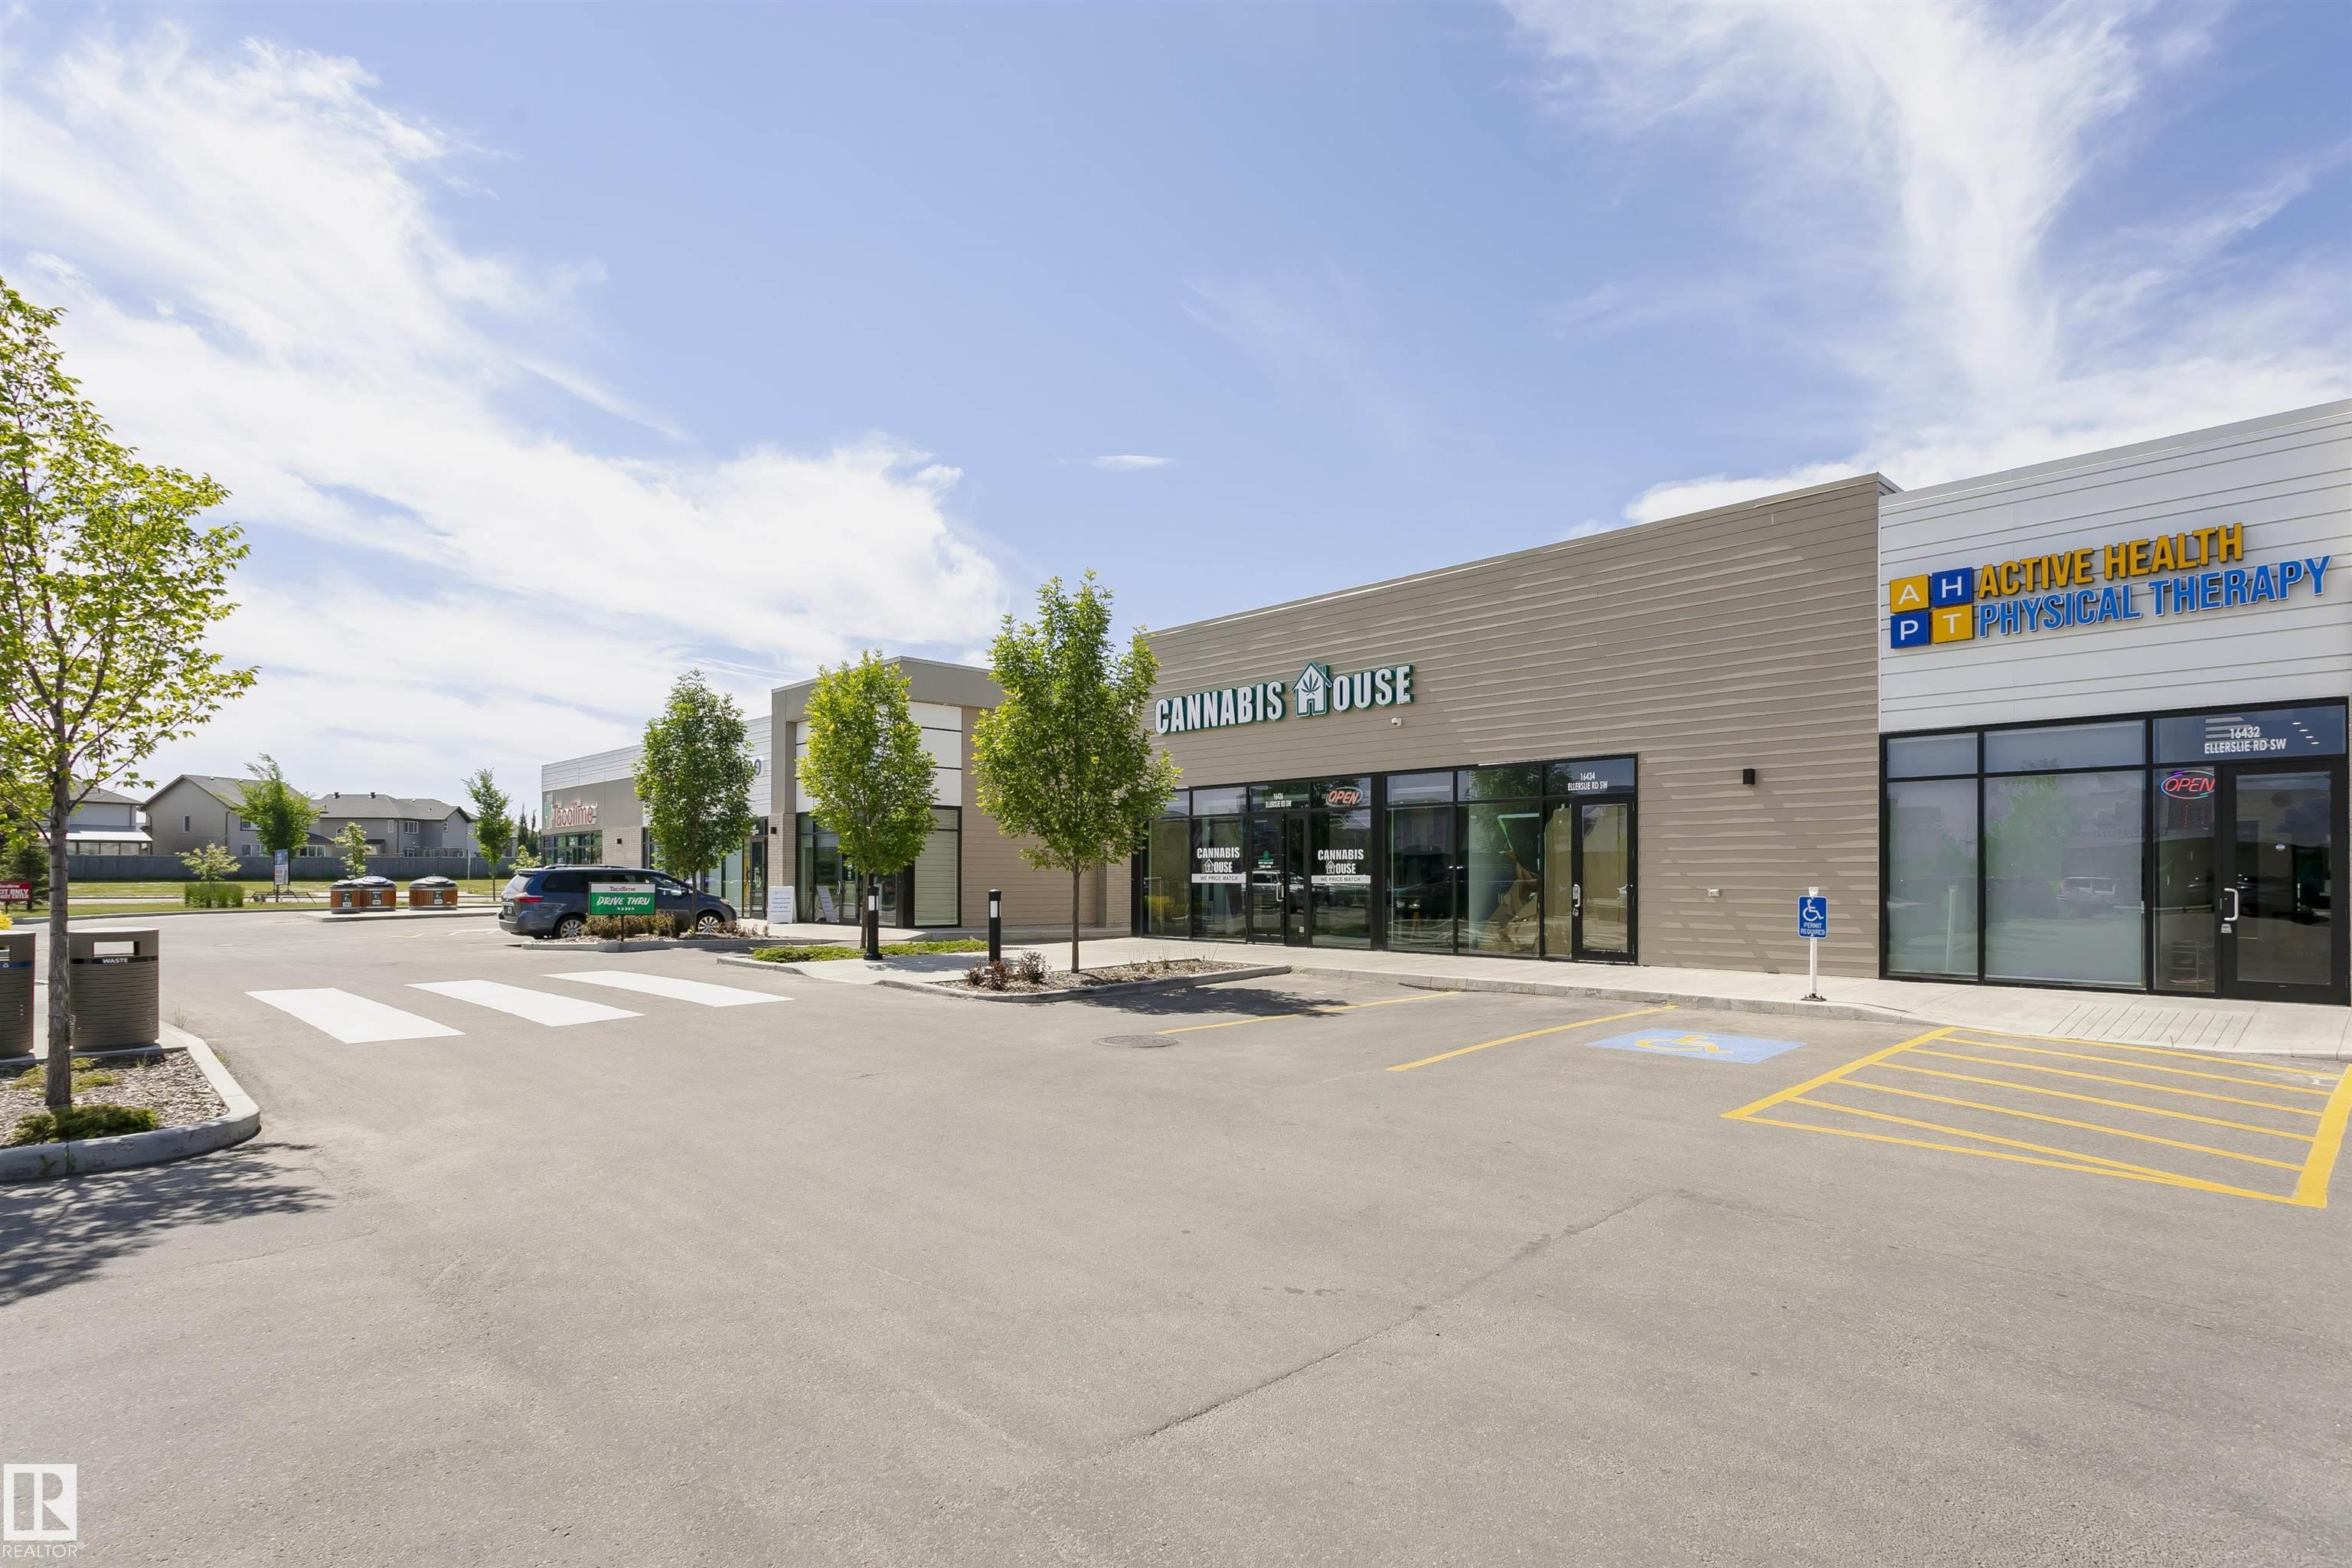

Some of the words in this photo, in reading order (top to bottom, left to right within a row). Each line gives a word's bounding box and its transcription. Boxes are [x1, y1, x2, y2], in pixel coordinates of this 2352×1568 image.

[1978, 547, 2095, 599] ACTIVE
[2103, 522, 2244, 581] HEALTH
[1898, 583, 1920, 605] A
[1941, 576, 1962, 599] H
[1978, 583, 2143, 638] PHYSICAL
[2147, 555, 2333, 617] THERAPY
[1900, 620, 1919, 641] P
[1942, 612, 1962, 635] T
[1155, 679, 1285, 735] CANNABIS
[2229, 726, 2260, 740] 16432
[2204, 740, 2250, 754] ELLERSLIE
[2252, 740, 2268, 751] RD
[2269, 738, 2287, 750] SW
[1580, 772, 1596, 780] 16434
[1568, 782, 1590, 791] ELLERSLIE
[1599, 781, 1608, 789] SW
[2165, 777, 2216, 792] OPEN
[1327, 789, 1360, 805] OPEN
[551, 799, 596, 827] TacoTime
[1197, 847, 1240, 858] CANNABIS
[1318, 849, 1364, 861] CANNABIS
[596, 896, 625, 906] DRIVE
[627, 897, 651, 906] THRU
